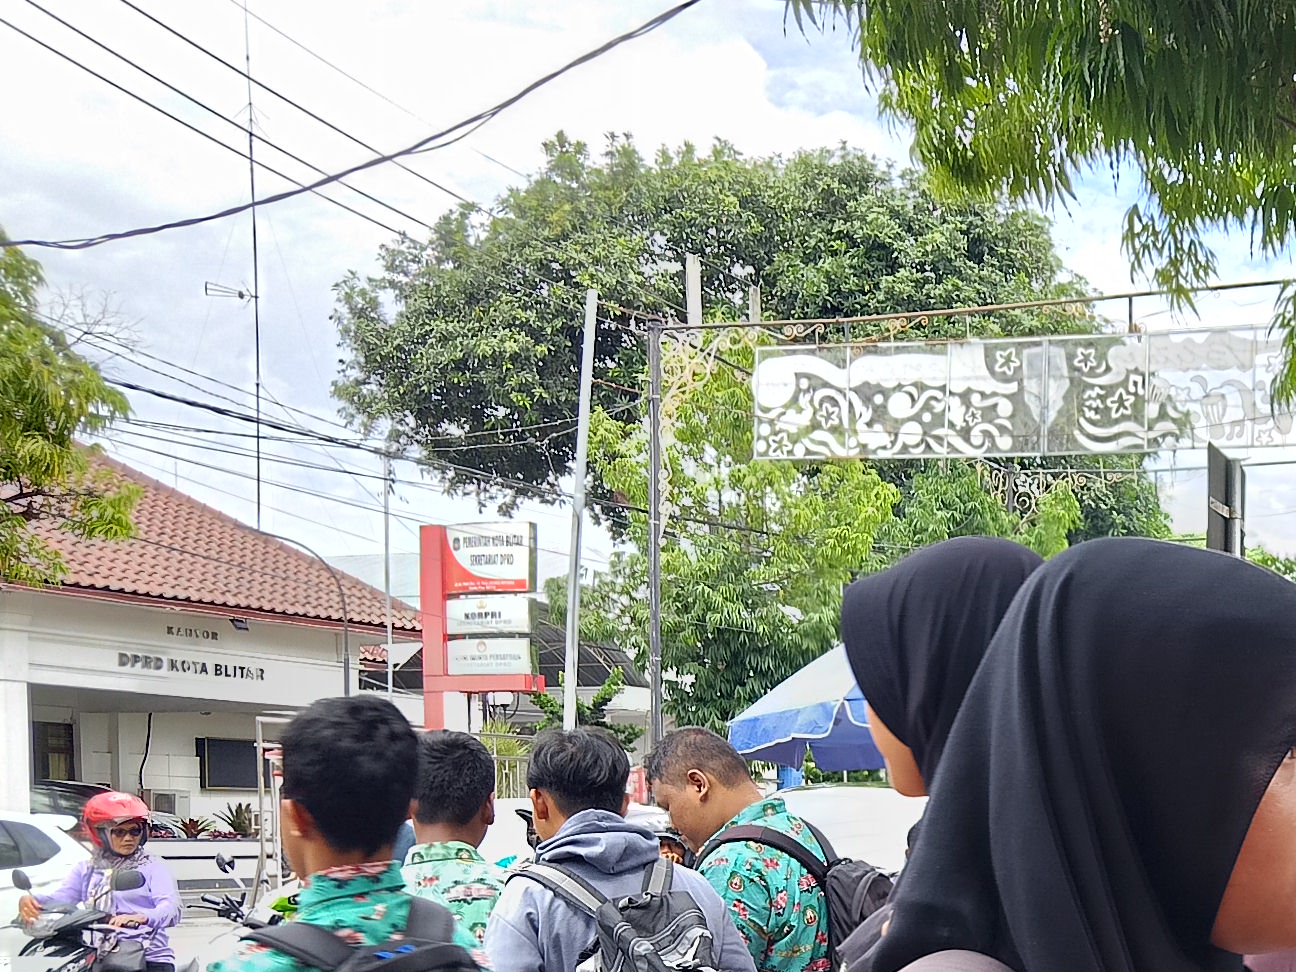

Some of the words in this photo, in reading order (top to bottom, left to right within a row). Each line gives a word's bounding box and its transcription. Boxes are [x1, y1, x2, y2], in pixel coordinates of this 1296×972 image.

[469, 553, 498, 566] SEKRETARIAT
[500, 553, 514, 565] DPRD
[464, 611, 502, 620] KORPRI
[166, 625, 219, 641] KANTOR
[117, 652, 164, 671] DPRD
[167, 658, 208, 675] KOTA
[214, 663, 265, 681] BLITAR
